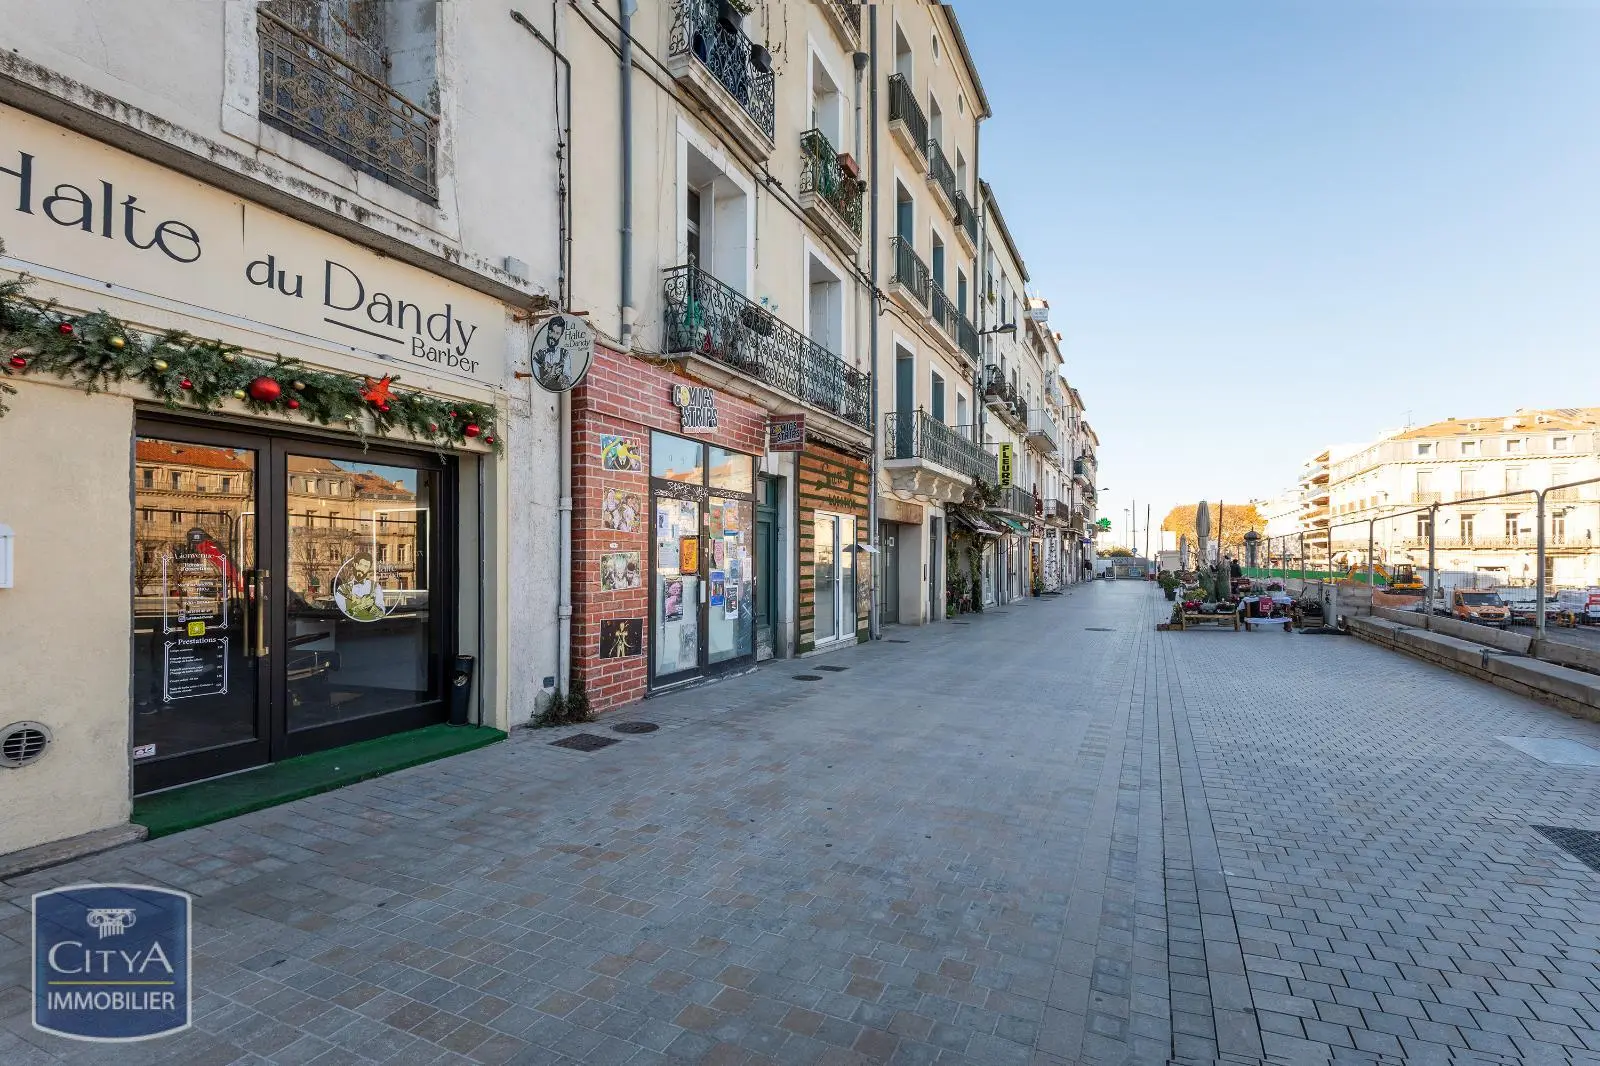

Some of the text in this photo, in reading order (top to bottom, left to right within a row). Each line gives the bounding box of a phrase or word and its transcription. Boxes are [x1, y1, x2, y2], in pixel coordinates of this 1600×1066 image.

[0, 150, 202, 264] Halte
[245, 254, 478, 357] du Dandy
[564, 330, 586, 340] Halte
[565, 321, 576, 330] La
[411, 336, 480, 374] Barber
[674, 384, 715, 408] COMICS
[683, 405, 718, 428] STRIPS
[771, 421, 797, 435] COMICS
[777, 429, 800, 441] STRIPS
[1002, 444, 1011, 486] FLEURS
